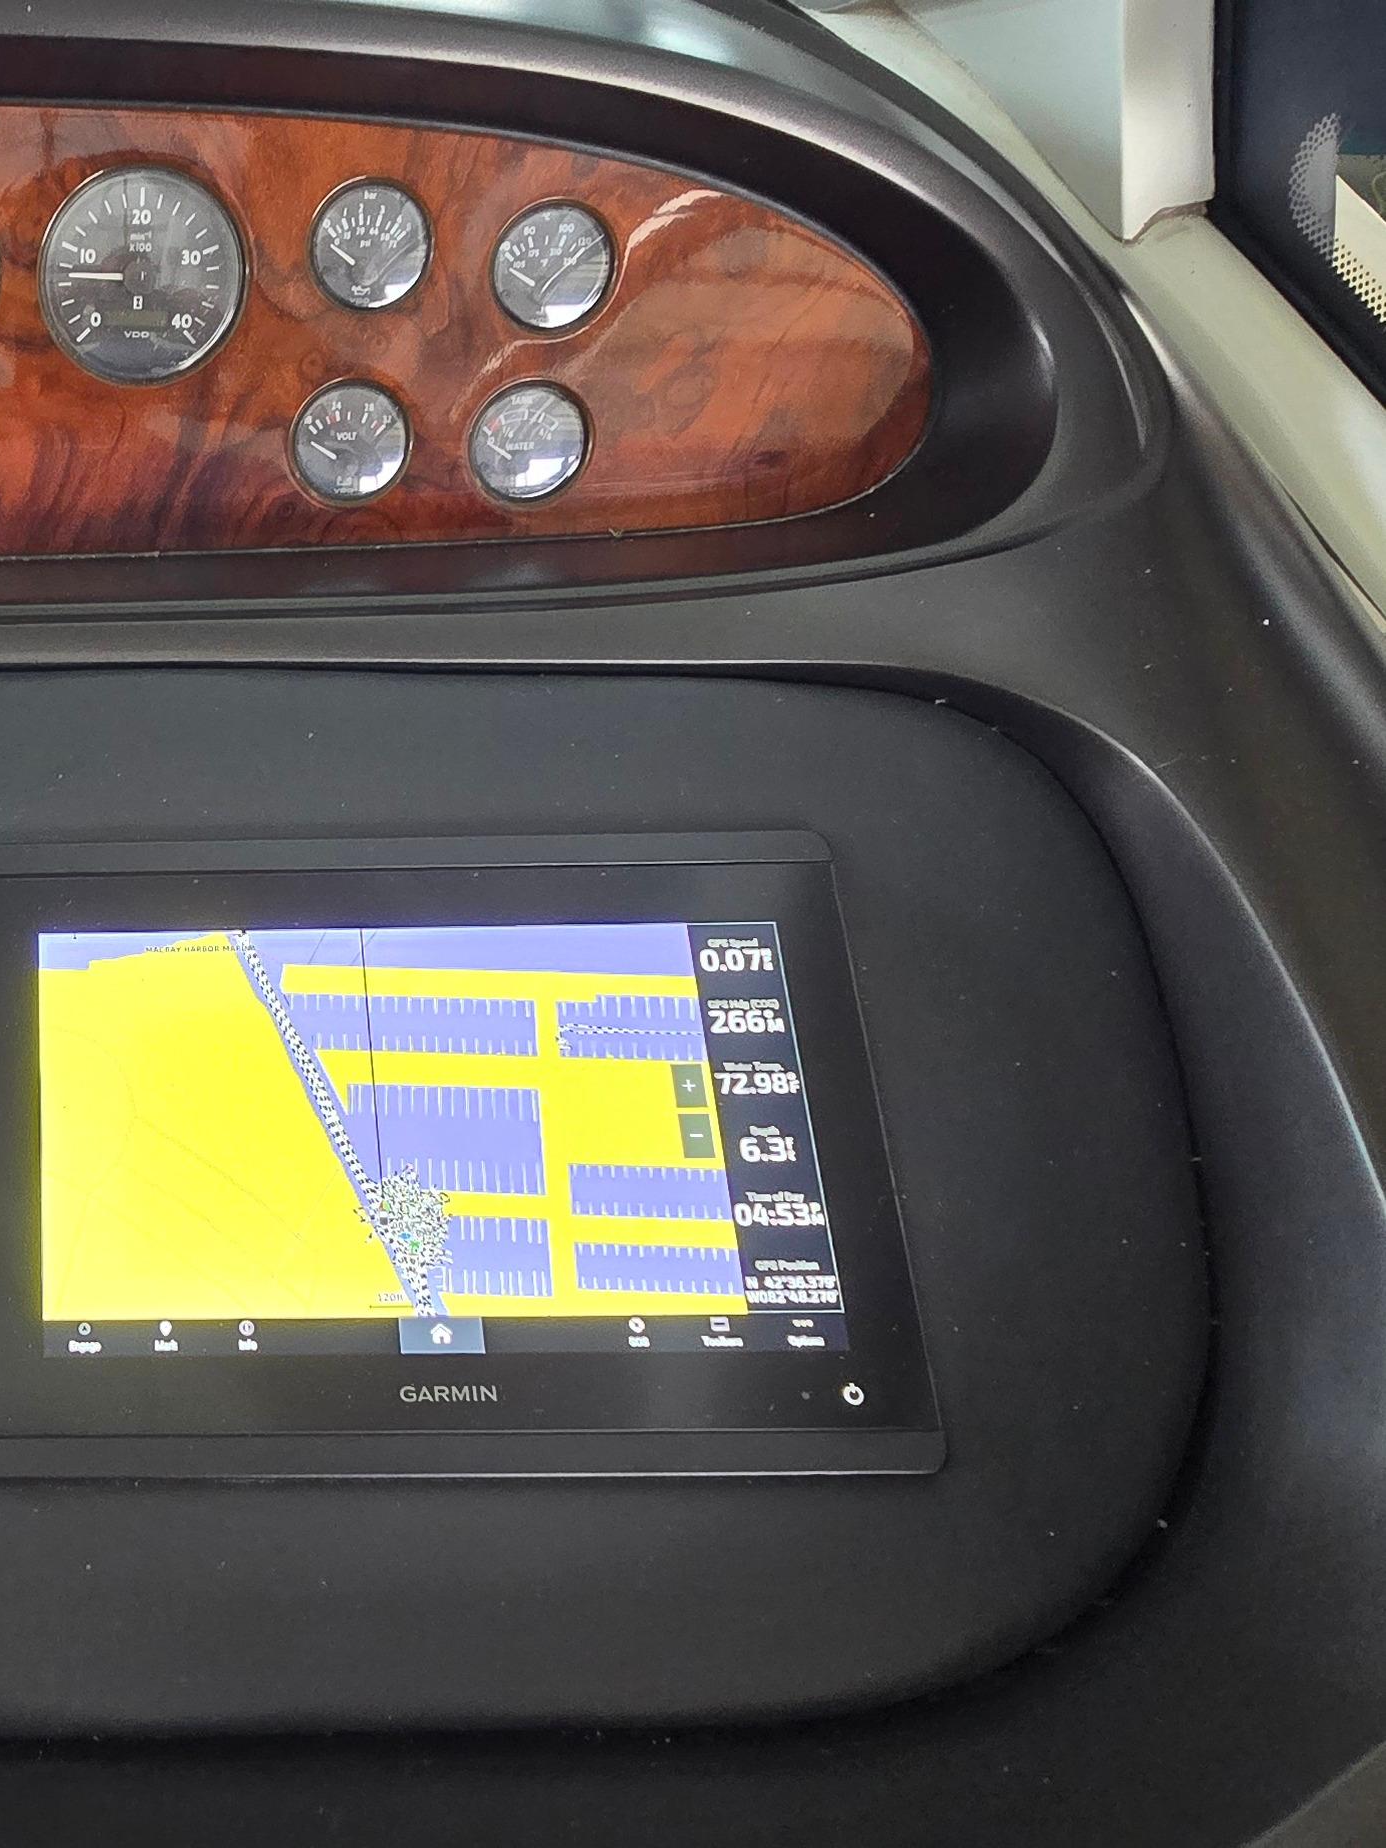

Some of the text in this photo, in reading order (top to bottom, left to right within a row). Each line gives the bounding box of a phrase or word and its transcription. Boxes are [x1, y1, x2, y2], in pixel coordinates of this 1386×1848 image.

[132, 210, 151, 225] 20
[559, 223, 575, 233] 100
[80, 249, 96, 264] 10
[181, 250, 201, 265] 30
[90, 312, 101, 327] 0
[171, 313, 192, 329] 40
[124, 330, 150, 339] VDO
[336, 432, 357, 440] VOLT
[399, 1385, 498, 1403] GARMIN
